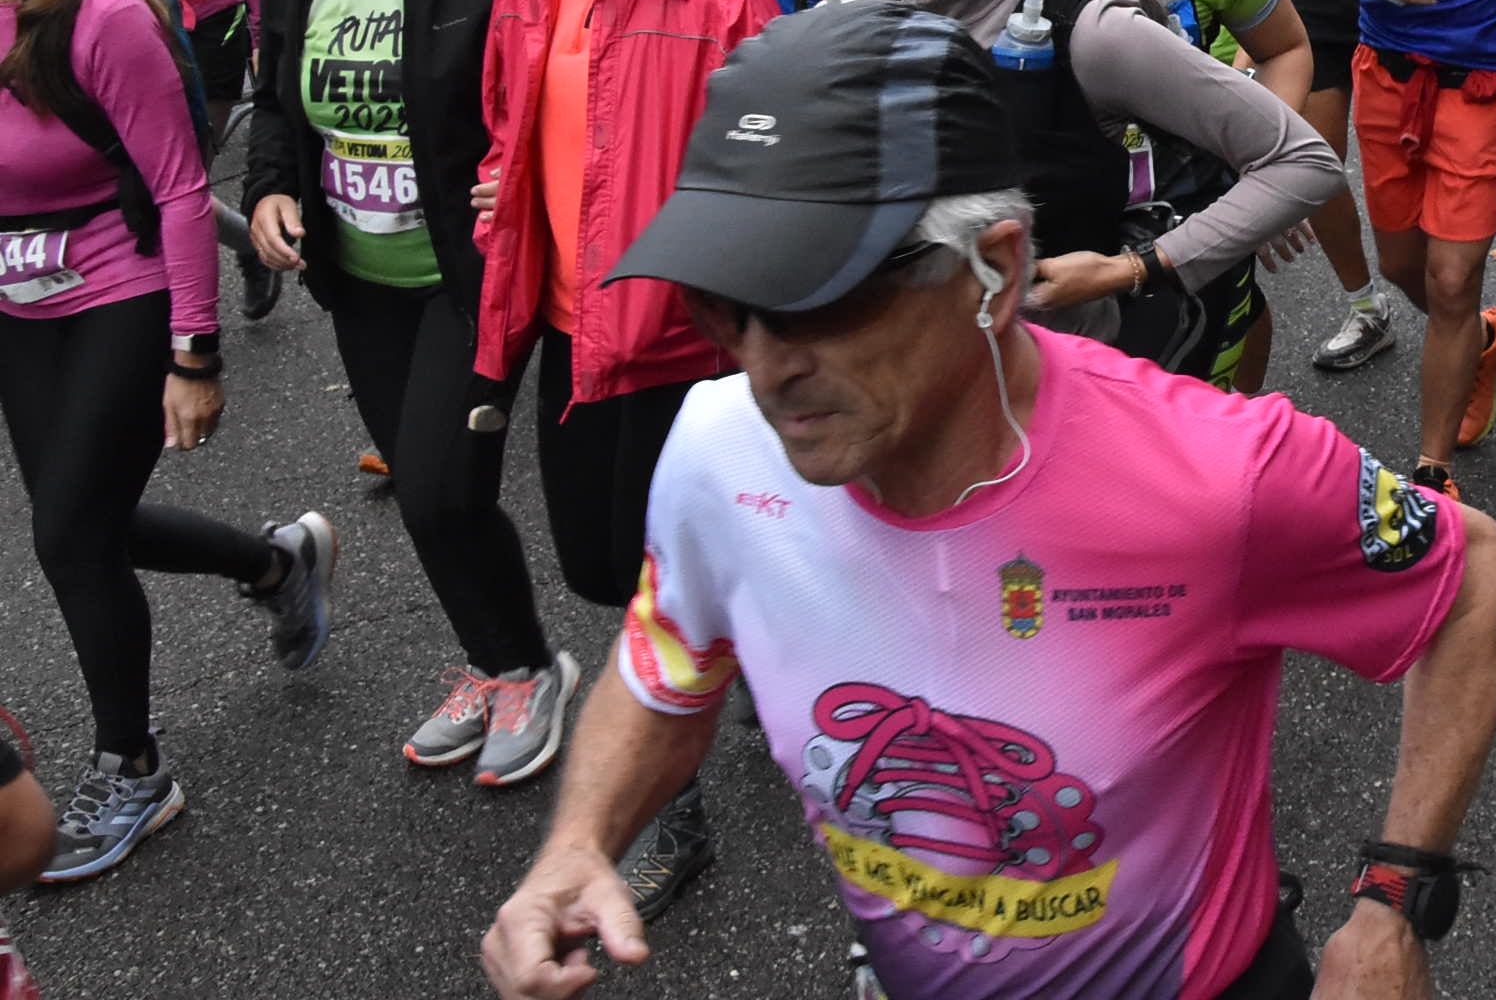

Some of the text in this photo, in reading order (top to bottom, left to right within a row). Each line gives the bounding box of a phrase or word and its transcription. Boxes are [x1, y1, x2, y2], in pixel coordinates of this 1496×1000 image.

[328, 8, 404, 58] RUTA
[348, 144, 389, 159] VETONA
[329, 159, 419, 204] 1546
[0, 233, 48, 276] 44
[1052, 583, 1187, 602] AYUNTAMIENTO DE
[1068, 603, 1171, 622] SAN MORALES
[994, 896, 1007, 920] A
[1015, 885, 1105, 922] BUSCAR
